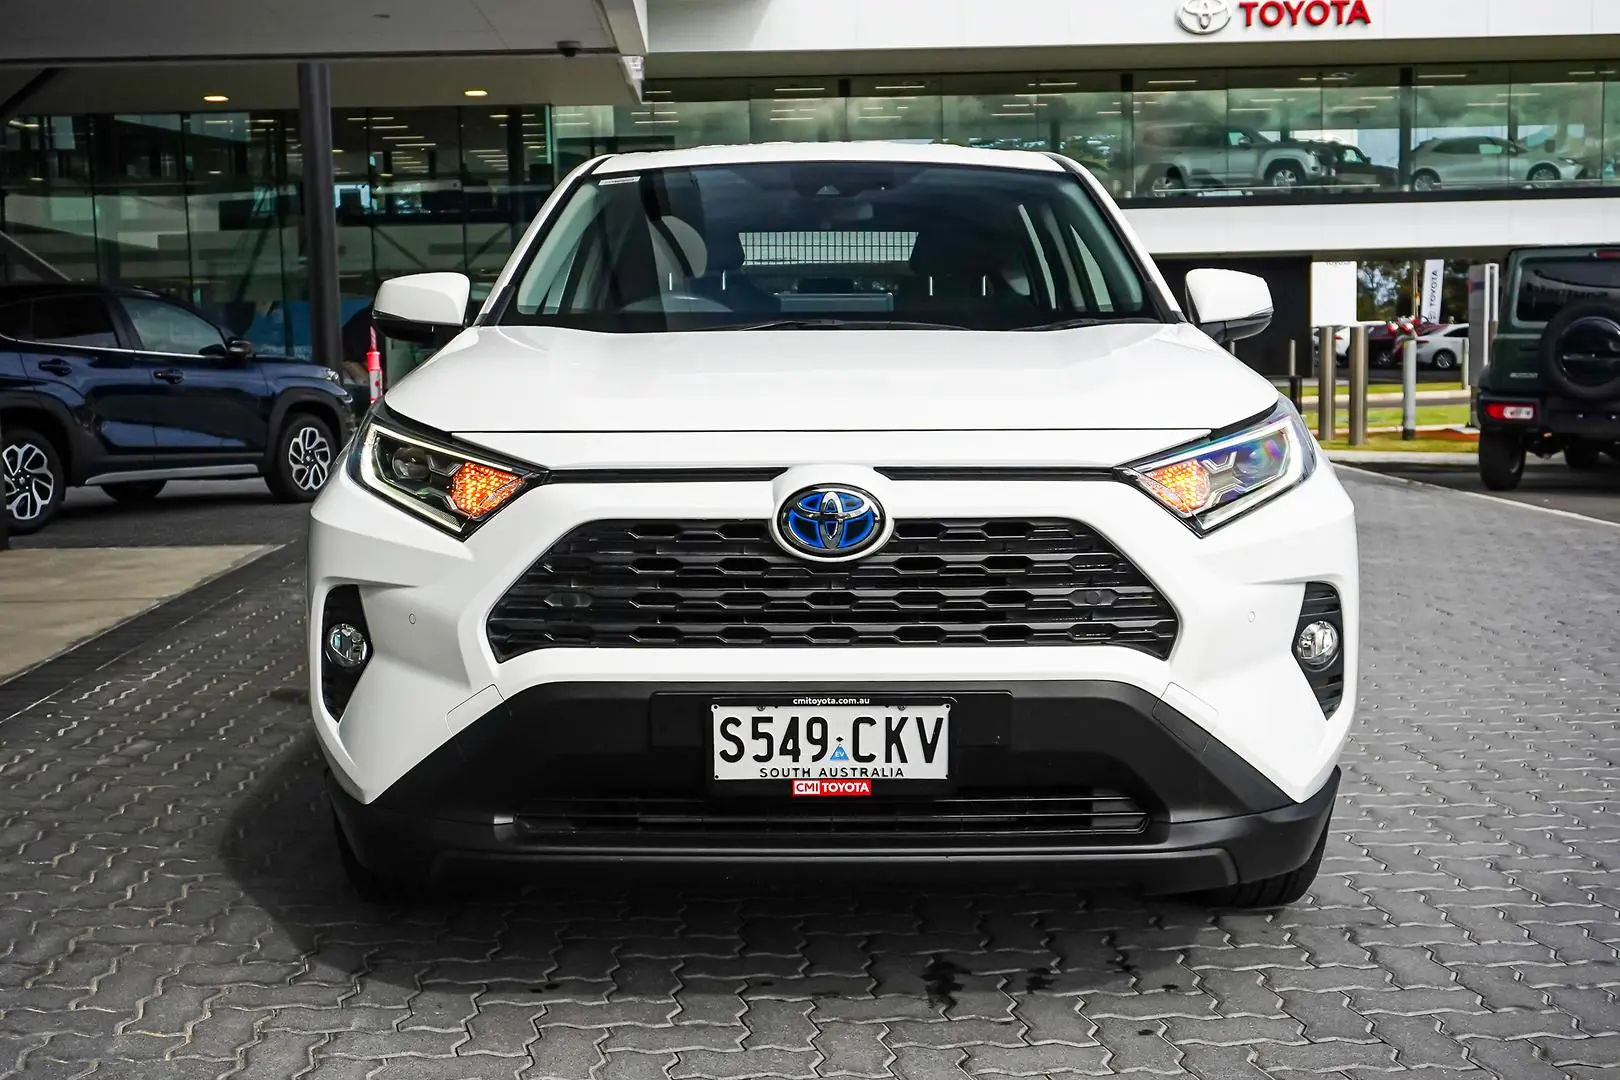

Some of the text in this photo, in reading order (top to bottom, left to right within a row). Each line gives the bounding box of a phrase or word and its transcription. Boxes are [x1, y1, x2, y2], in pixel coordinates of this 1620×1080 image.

[1239, 0, 1371, 27] TOYOTA
[1429, 270, 1438, 306] TOYOTA
[793, 697, 870, 705] cmitoyota.com.au
[719, 716, 944, 763] S549 CKV
[759, 767, 904, 778] SOUTH AUSTRALIA
[795, 782, 869, 793] CMI TOYOTA
